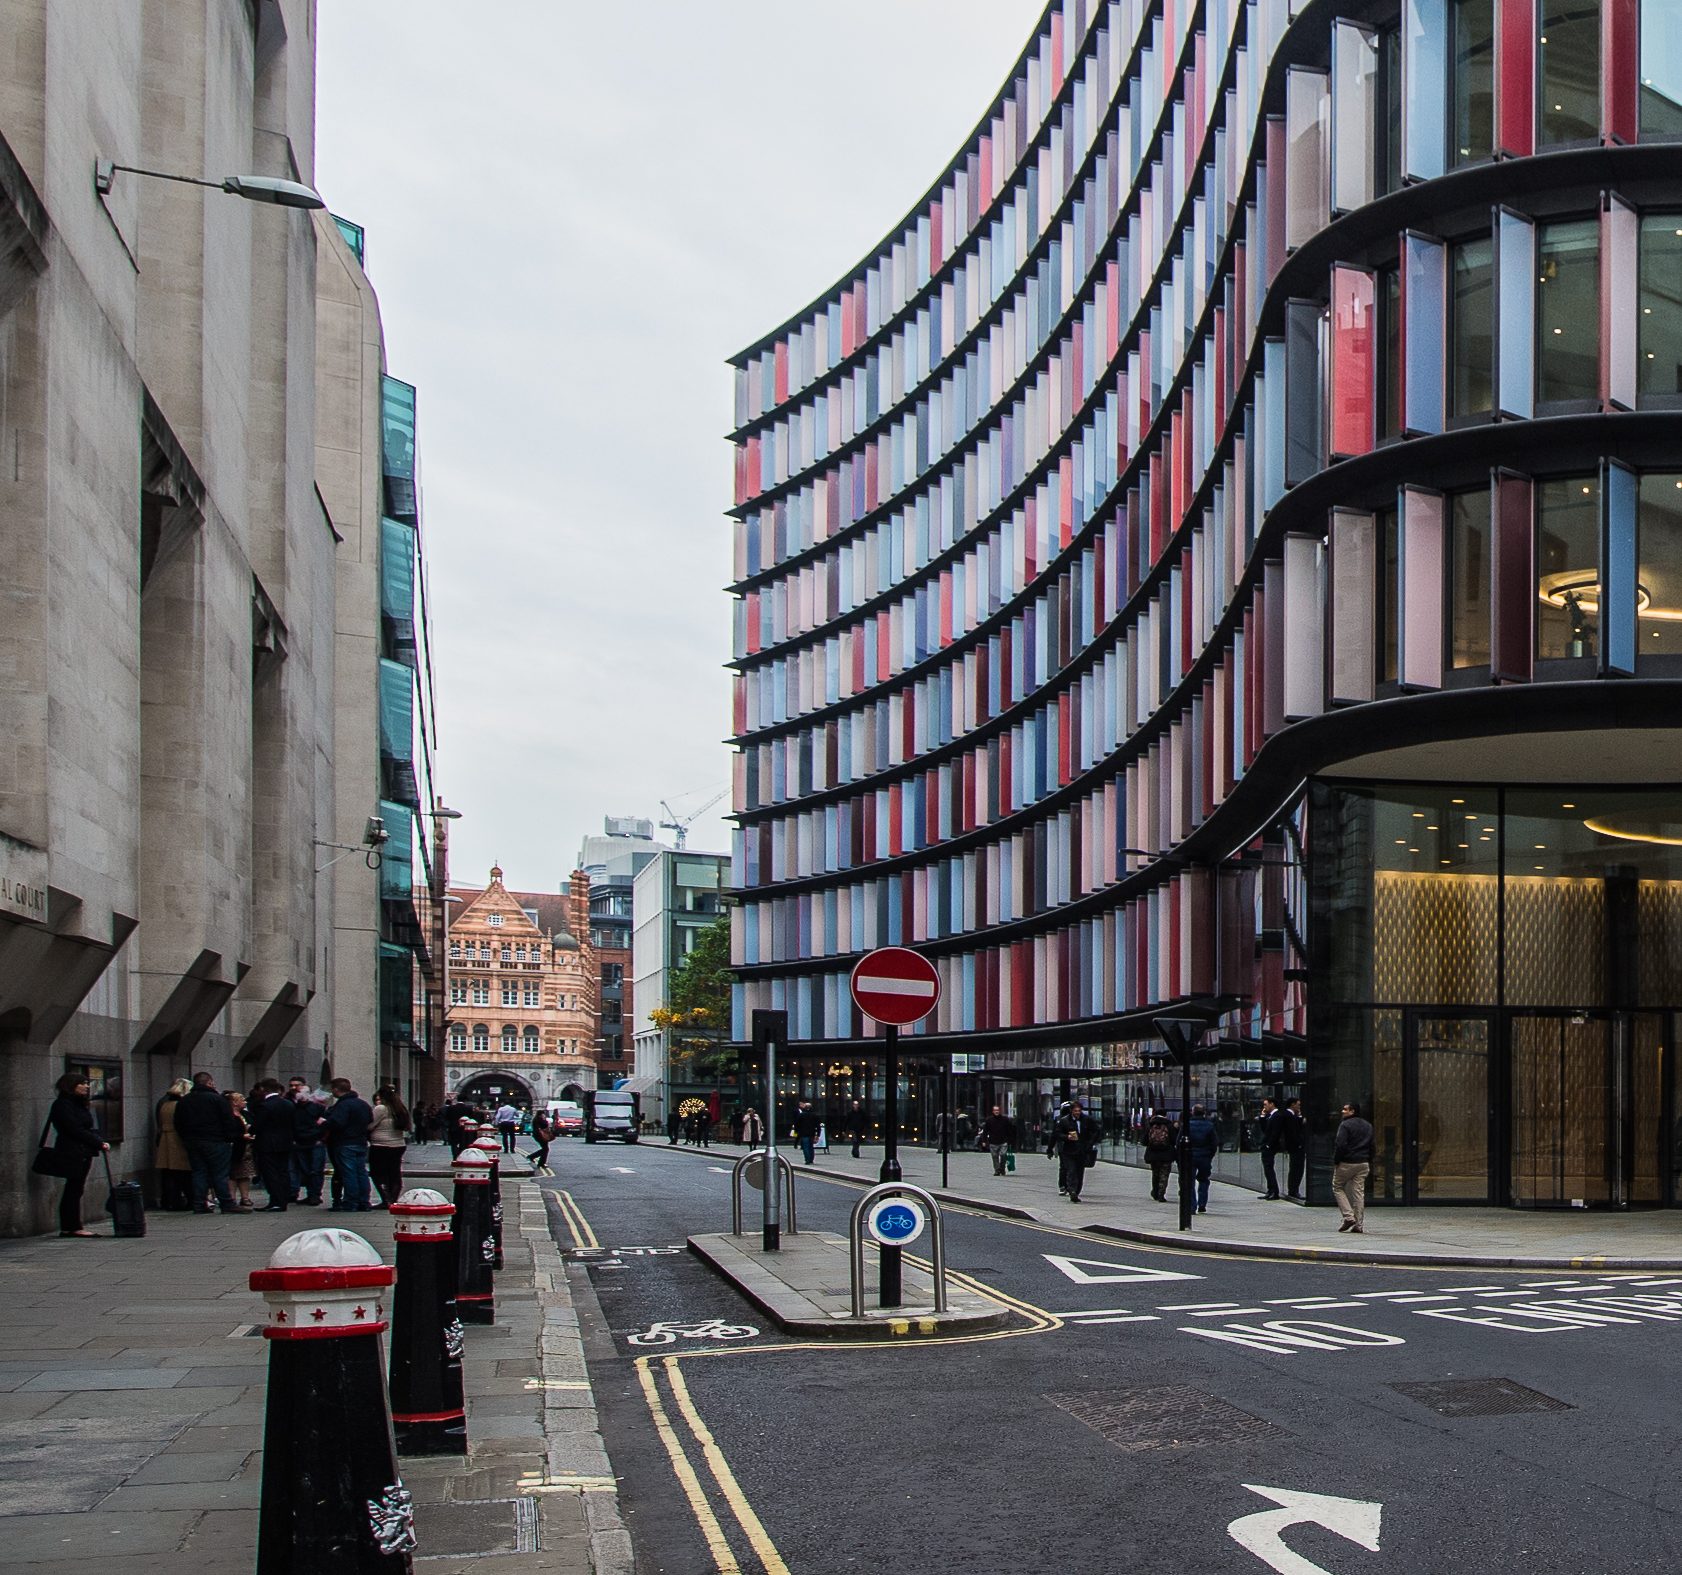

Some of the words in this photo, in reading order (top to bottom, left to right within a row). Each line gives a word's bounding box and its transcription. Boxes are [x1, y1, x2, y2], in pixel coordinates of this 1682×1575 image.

[15, 883, 45, 911] COURT
[575, 1249, 681, 1257] END
[1177, 1320, 1406, 1355] NO
